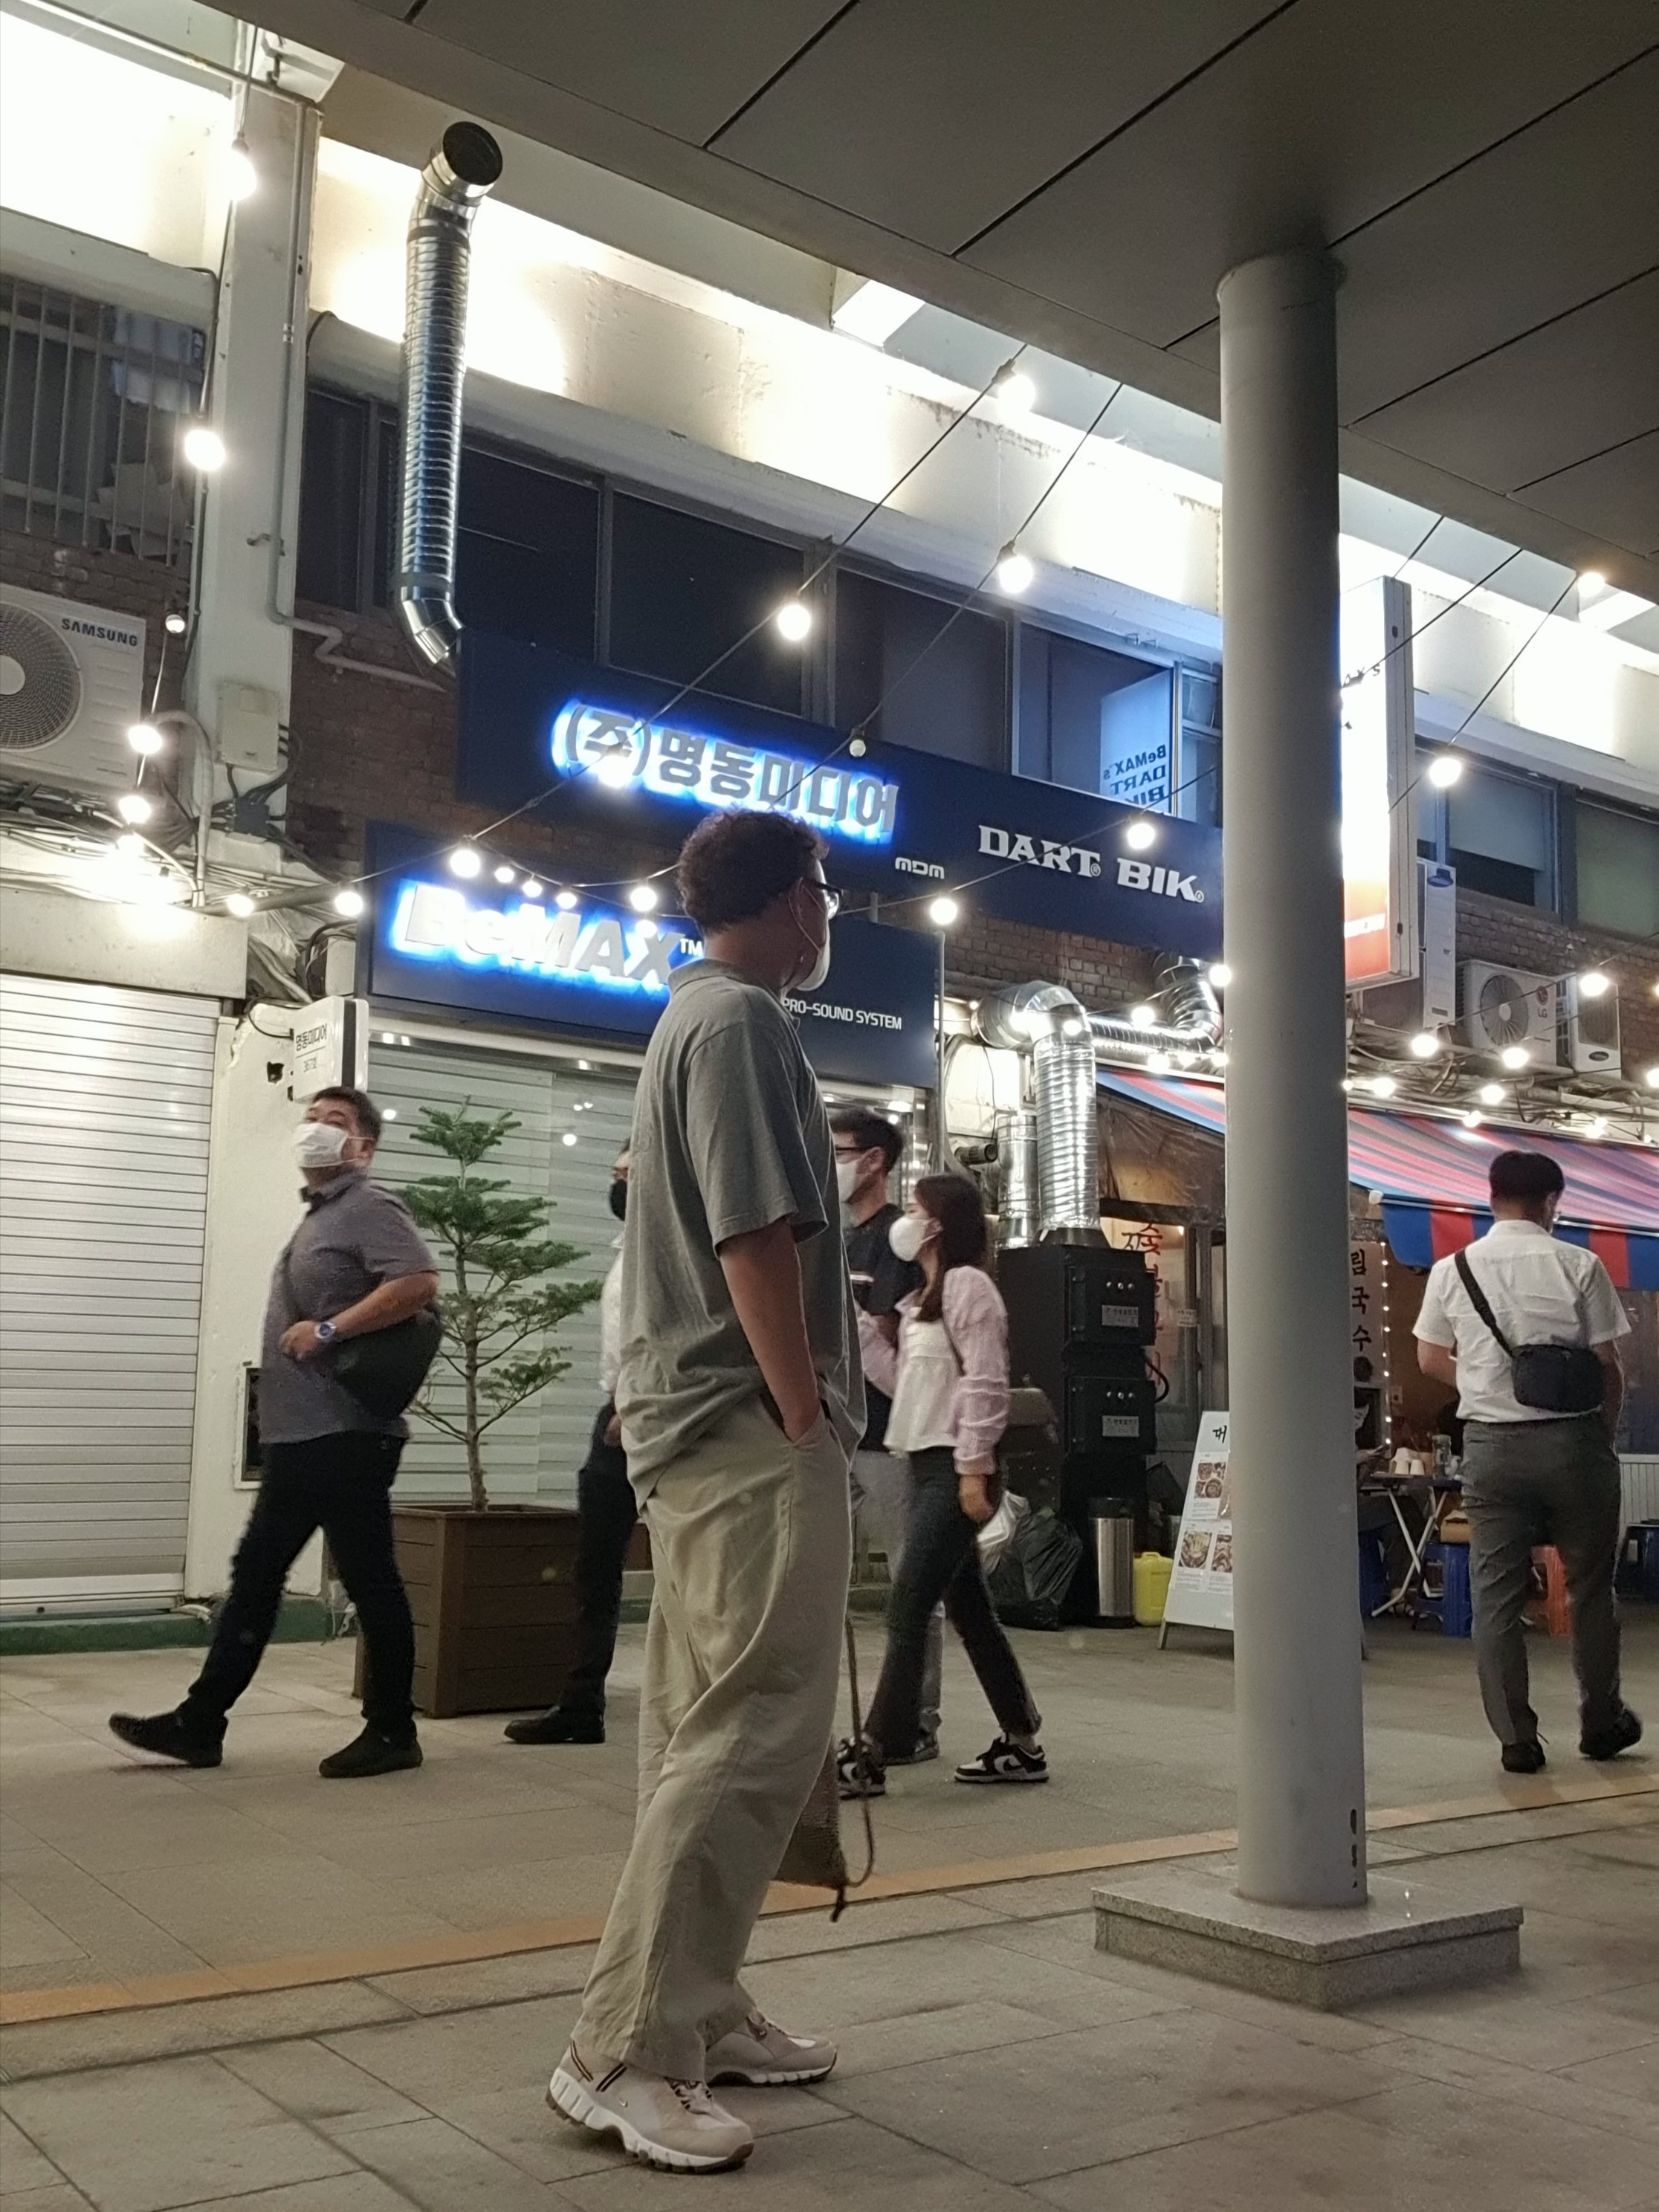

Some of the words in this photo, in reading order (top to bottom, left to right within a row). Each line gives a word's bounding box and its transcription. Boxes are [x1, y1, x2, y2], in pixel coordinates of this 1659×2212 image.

[61, 618, 138, 647] SAMSUNG
[782, 997, 853, 1022] PRO-SOUND
[856, 1010, 902, 1030] SYSTEM
[296, 1023, 327, 1052] 명동미디어
